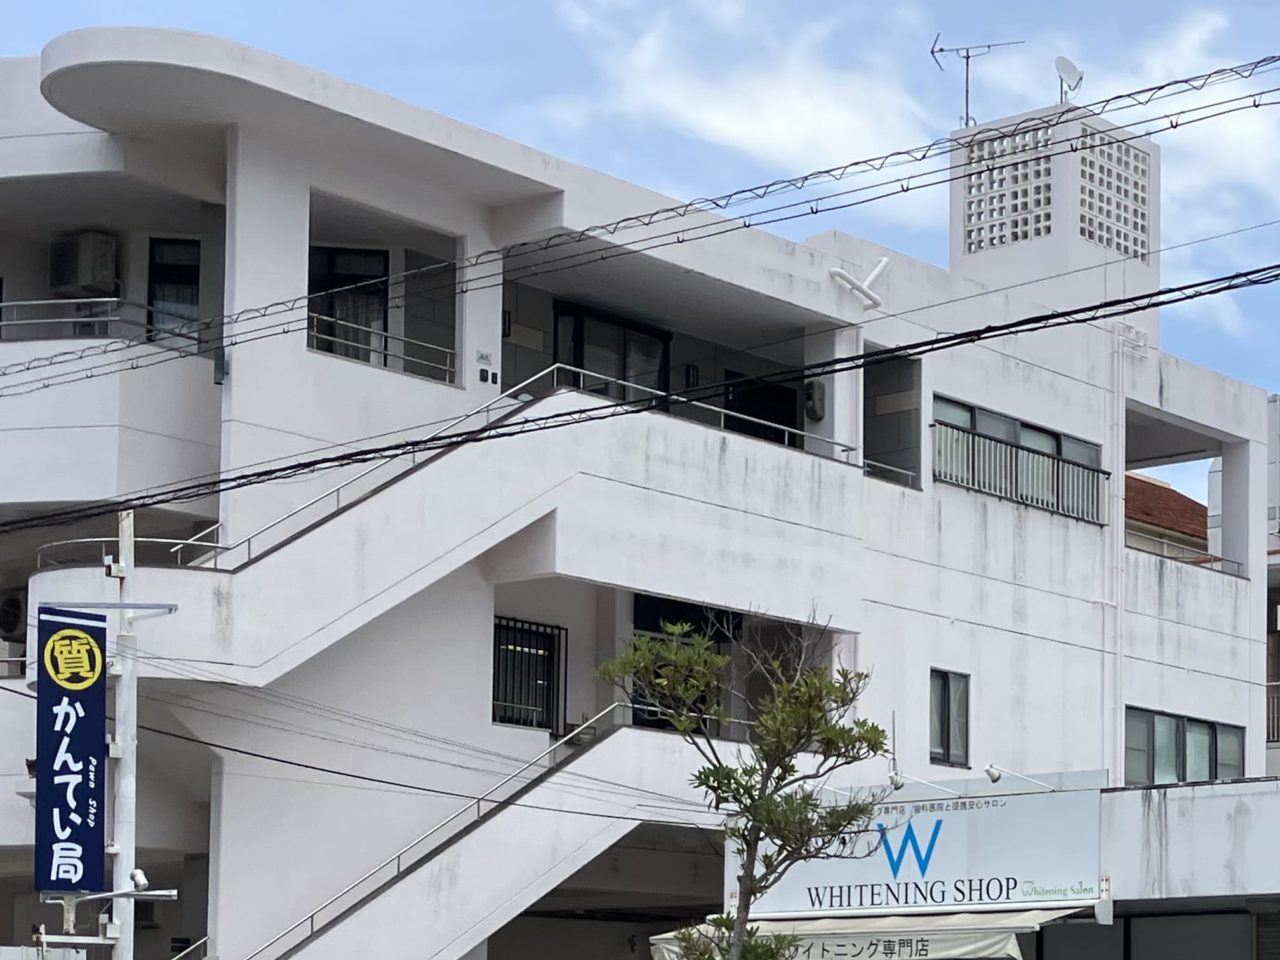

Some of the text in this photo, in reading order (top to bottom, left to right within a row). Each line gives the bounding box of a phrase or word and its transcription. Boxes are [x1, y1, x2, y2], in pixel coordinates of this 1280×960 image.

[53, 638, 96, 681] 質
[50, 696, 85, 884] かんてい局
[877, 819, 943, 880] W
[807, 877, 1018, 909] WHITENING SHOP
[1071, 881, 1094, 896] Salon
